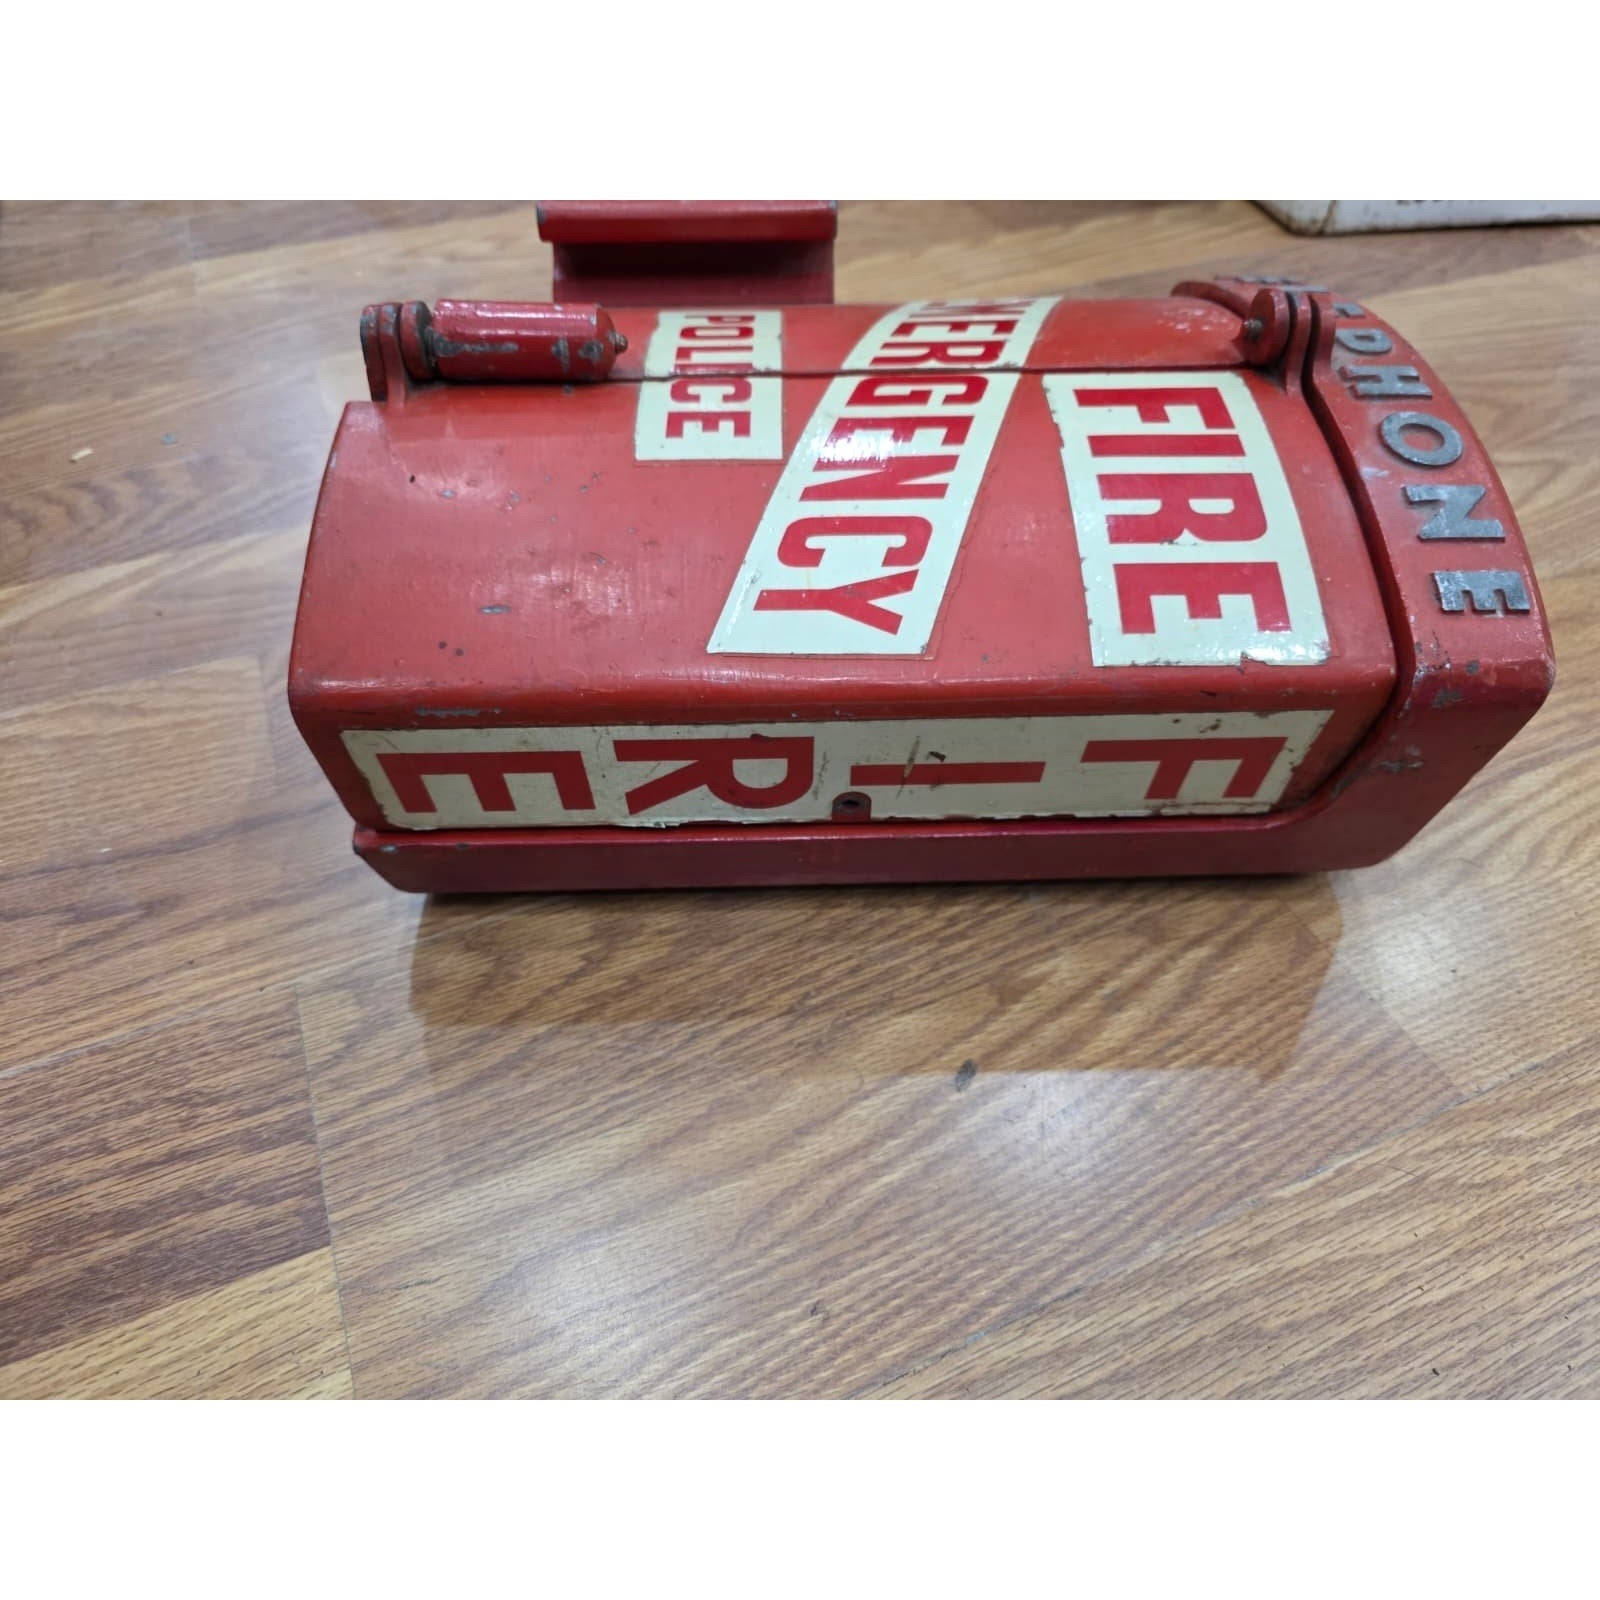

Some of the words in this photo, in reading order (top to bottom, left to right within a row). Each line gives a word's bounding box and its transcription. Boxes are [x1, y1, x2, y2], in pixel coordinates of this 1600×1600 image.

[665, 314, 755, 439] POLICE
[753, 299, 1034, 636] MERGENCY
[1073, 386, 1292, 634] FIRE
[375, 735, 1289, 816] FIRE
